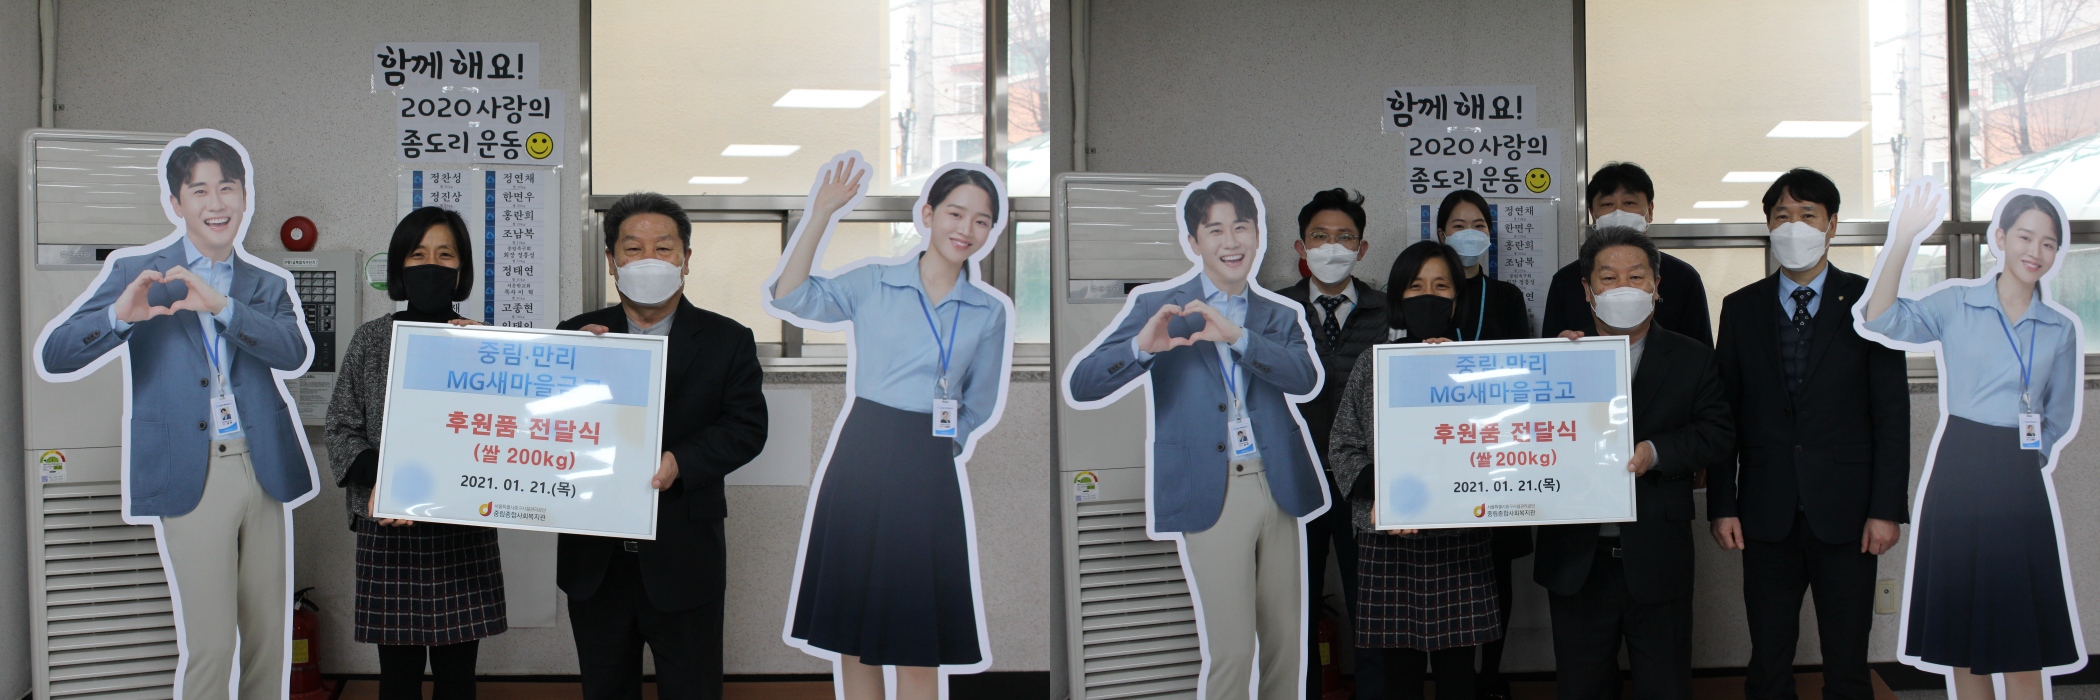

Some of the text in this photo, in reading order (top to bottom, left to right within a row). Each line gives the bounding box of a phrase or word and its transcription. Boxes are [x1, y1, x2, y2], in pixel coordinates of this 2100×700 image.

[377, 45, 524, 87] 함께 해요!
[401, 94, 550, 124] 2020 사랑의
[1386, 89, 1523, 128] 함께 해요!
[401, 129, 522, 160] 좀도리 운동
[1409, 133, 1548, 161] 2020 사랑의
[430, 172, 461, 184] 정찬성
[503, 172, 535, 184] 정연채
[1409, 166, 1522, 194] 좀도리 운동
[430, 191, 462, 203] 정진상
[502, 209, 534, 221] 홍란희
[1504, 205, 1534, 217] 정연채
[502, 228, 535, 240] 조남복
[1504, 239, 1534, 251] 홍란희
[502, 265, 534, 277] 정태연
[1504, 257, 1535, 268] 조남복
[501, 302, 534, 314] 고종현
[478, 341, 577, 371] 중림·만리
[447, 370, 601, 398] MG새마을금
[1430, 380, 1576, 404] MG새마을금고
[445, 411, 601, 446] 후원품 전달식
[1433, 420, 1577, 445] 후원품 전달식
[473, 443, 576, 471] (쌀 200kg)
[1469, 448, 1557, 468] (쌀 200kg)
[460, 475, 577, 499] 2021. 01. 21.(목)
[1453, 477, 1561, 493] 2021. 01. 21.(목)
